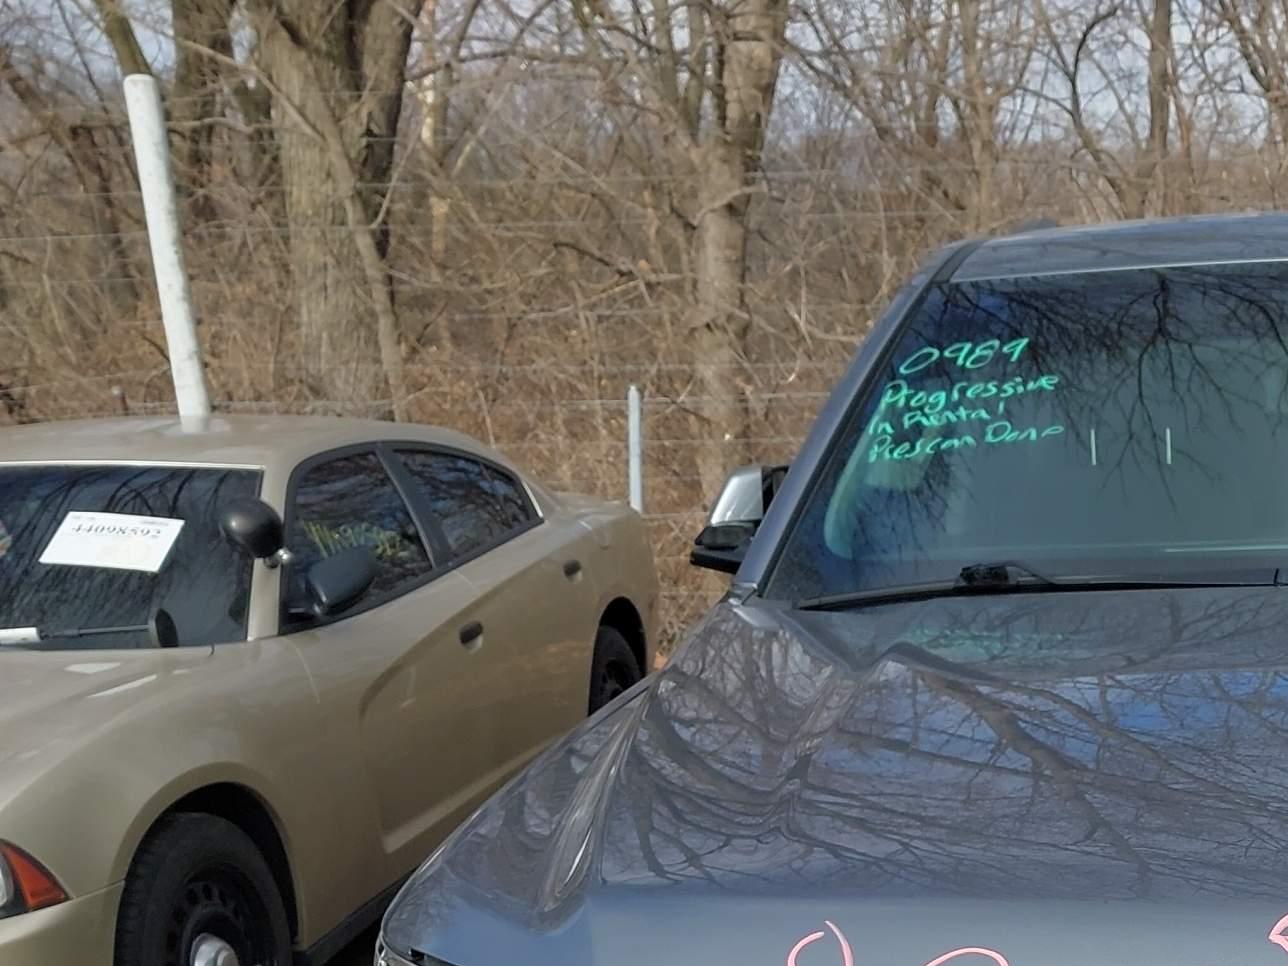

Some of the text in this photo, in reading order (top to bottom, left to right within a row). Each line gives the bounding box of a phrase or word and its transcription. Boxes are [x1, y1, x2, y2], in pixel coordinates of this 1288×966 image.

[880, 374, 1059, 412] Progressive
[903, 400, 1005, 430] Rental
[984, 421, 1065, 444] Done
